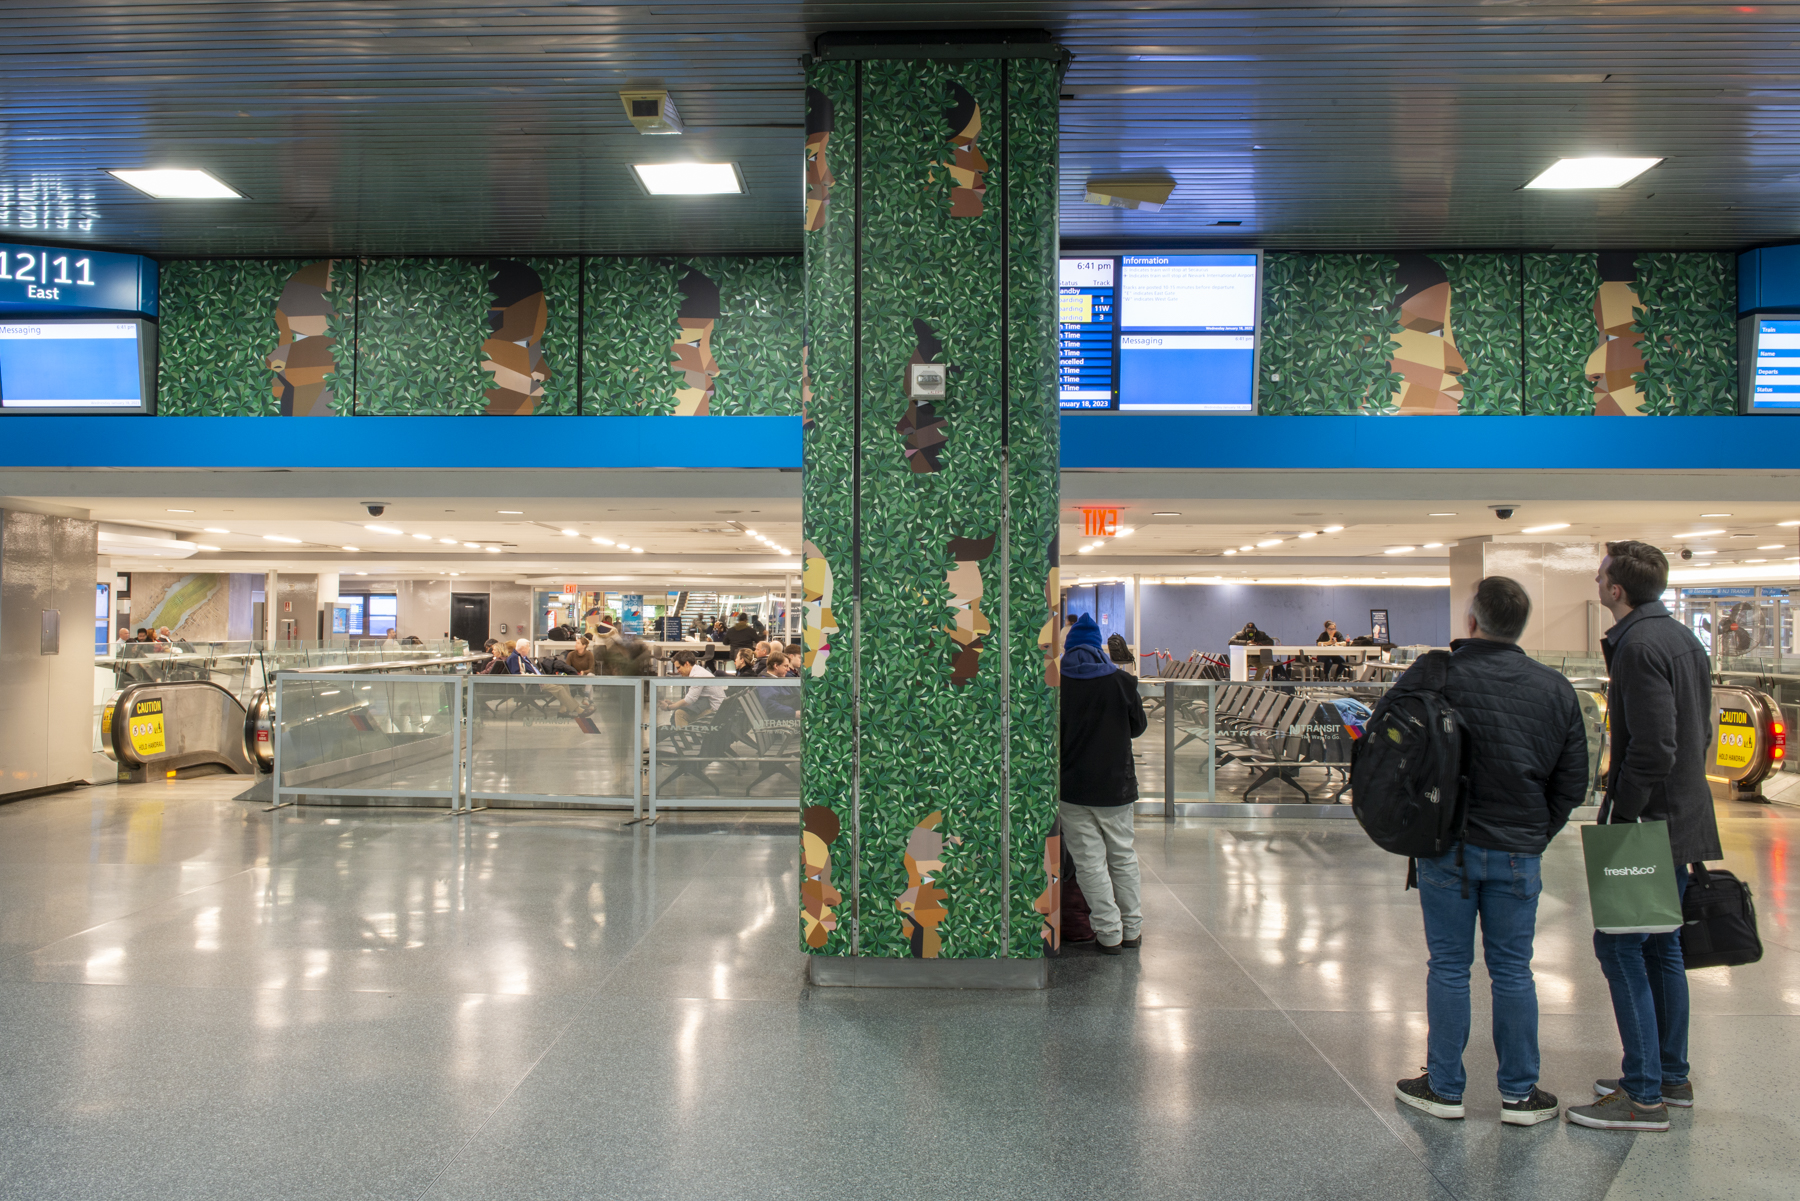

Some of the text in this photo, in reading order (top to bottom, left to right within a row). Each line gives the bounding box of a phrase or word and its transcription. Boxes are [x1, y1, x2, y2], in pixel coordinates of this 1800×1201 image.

[1123, 256, 1169, 265] Information
[1077, 262, 1095, 270] 6:41
[28, 285, 60, 300] East
[1060, 287, 1081, 296] andby
[0, 326, 41, 336] Messaging
[1122, 337, 1163, 346] Messaging
[1060, 401, 1080, 409] anuary
[565, 584, 577, 593] EXIT
[136, 700, 162, 714] CAUTION
[534, 717, 572, 725] TRANSIT
[1721, 710, 1748, 724] CAUTION
[1300, 725, 1341, 733] TRANSIT
[139, 741, 164, 751] HOLD HANDRAIL
[1718, 753, 1746, 763] HOLD HANDRAIL
